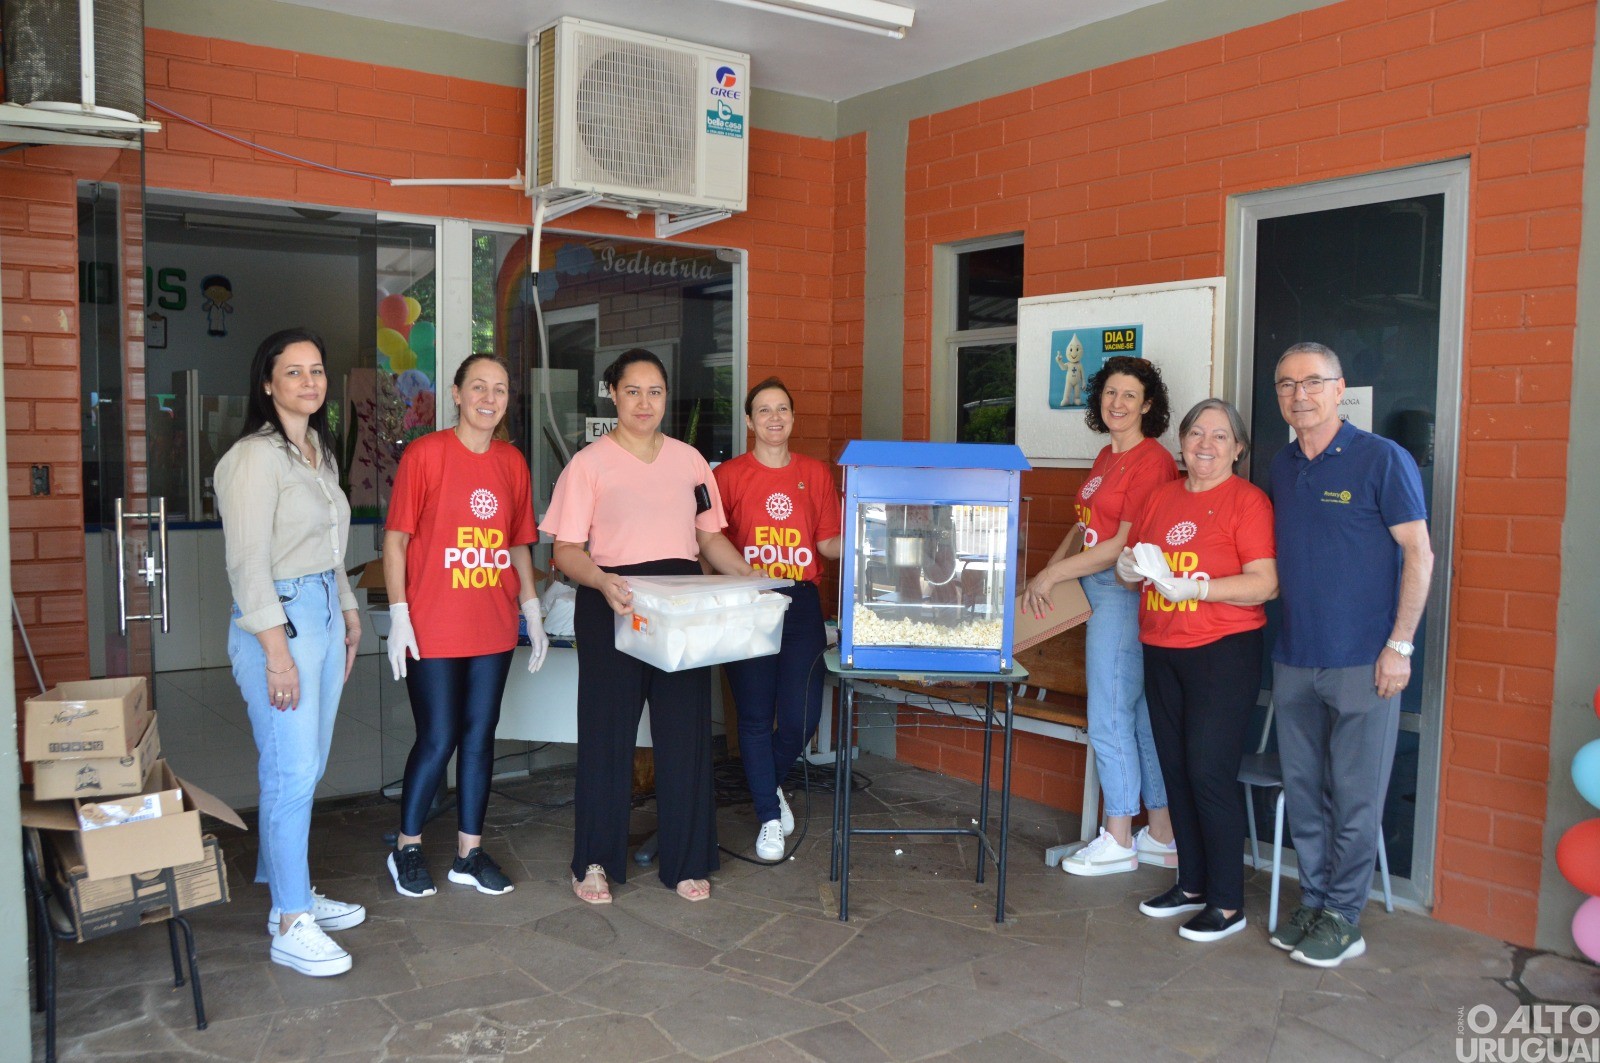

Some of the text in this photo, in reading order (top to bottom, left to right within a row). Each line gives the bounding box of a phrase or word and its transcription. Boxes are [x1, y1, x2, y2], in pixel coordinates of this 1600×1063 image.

[710, 86, 741, 100] GREE
[707, 116, 725, 127] bella
[725, 120, 742, 130] casa
[601, 246, 714, 279] Pediatria
[1105, 330, 1134, 343] DIA D
[1105, 342, 1134, 351] VACINE-SE
[457, 526, 504, 549] END
[755, 525, 801, 547] END
[743, 544, 813, 567] POLIO
[1162, 551, 1199, 572] ND
